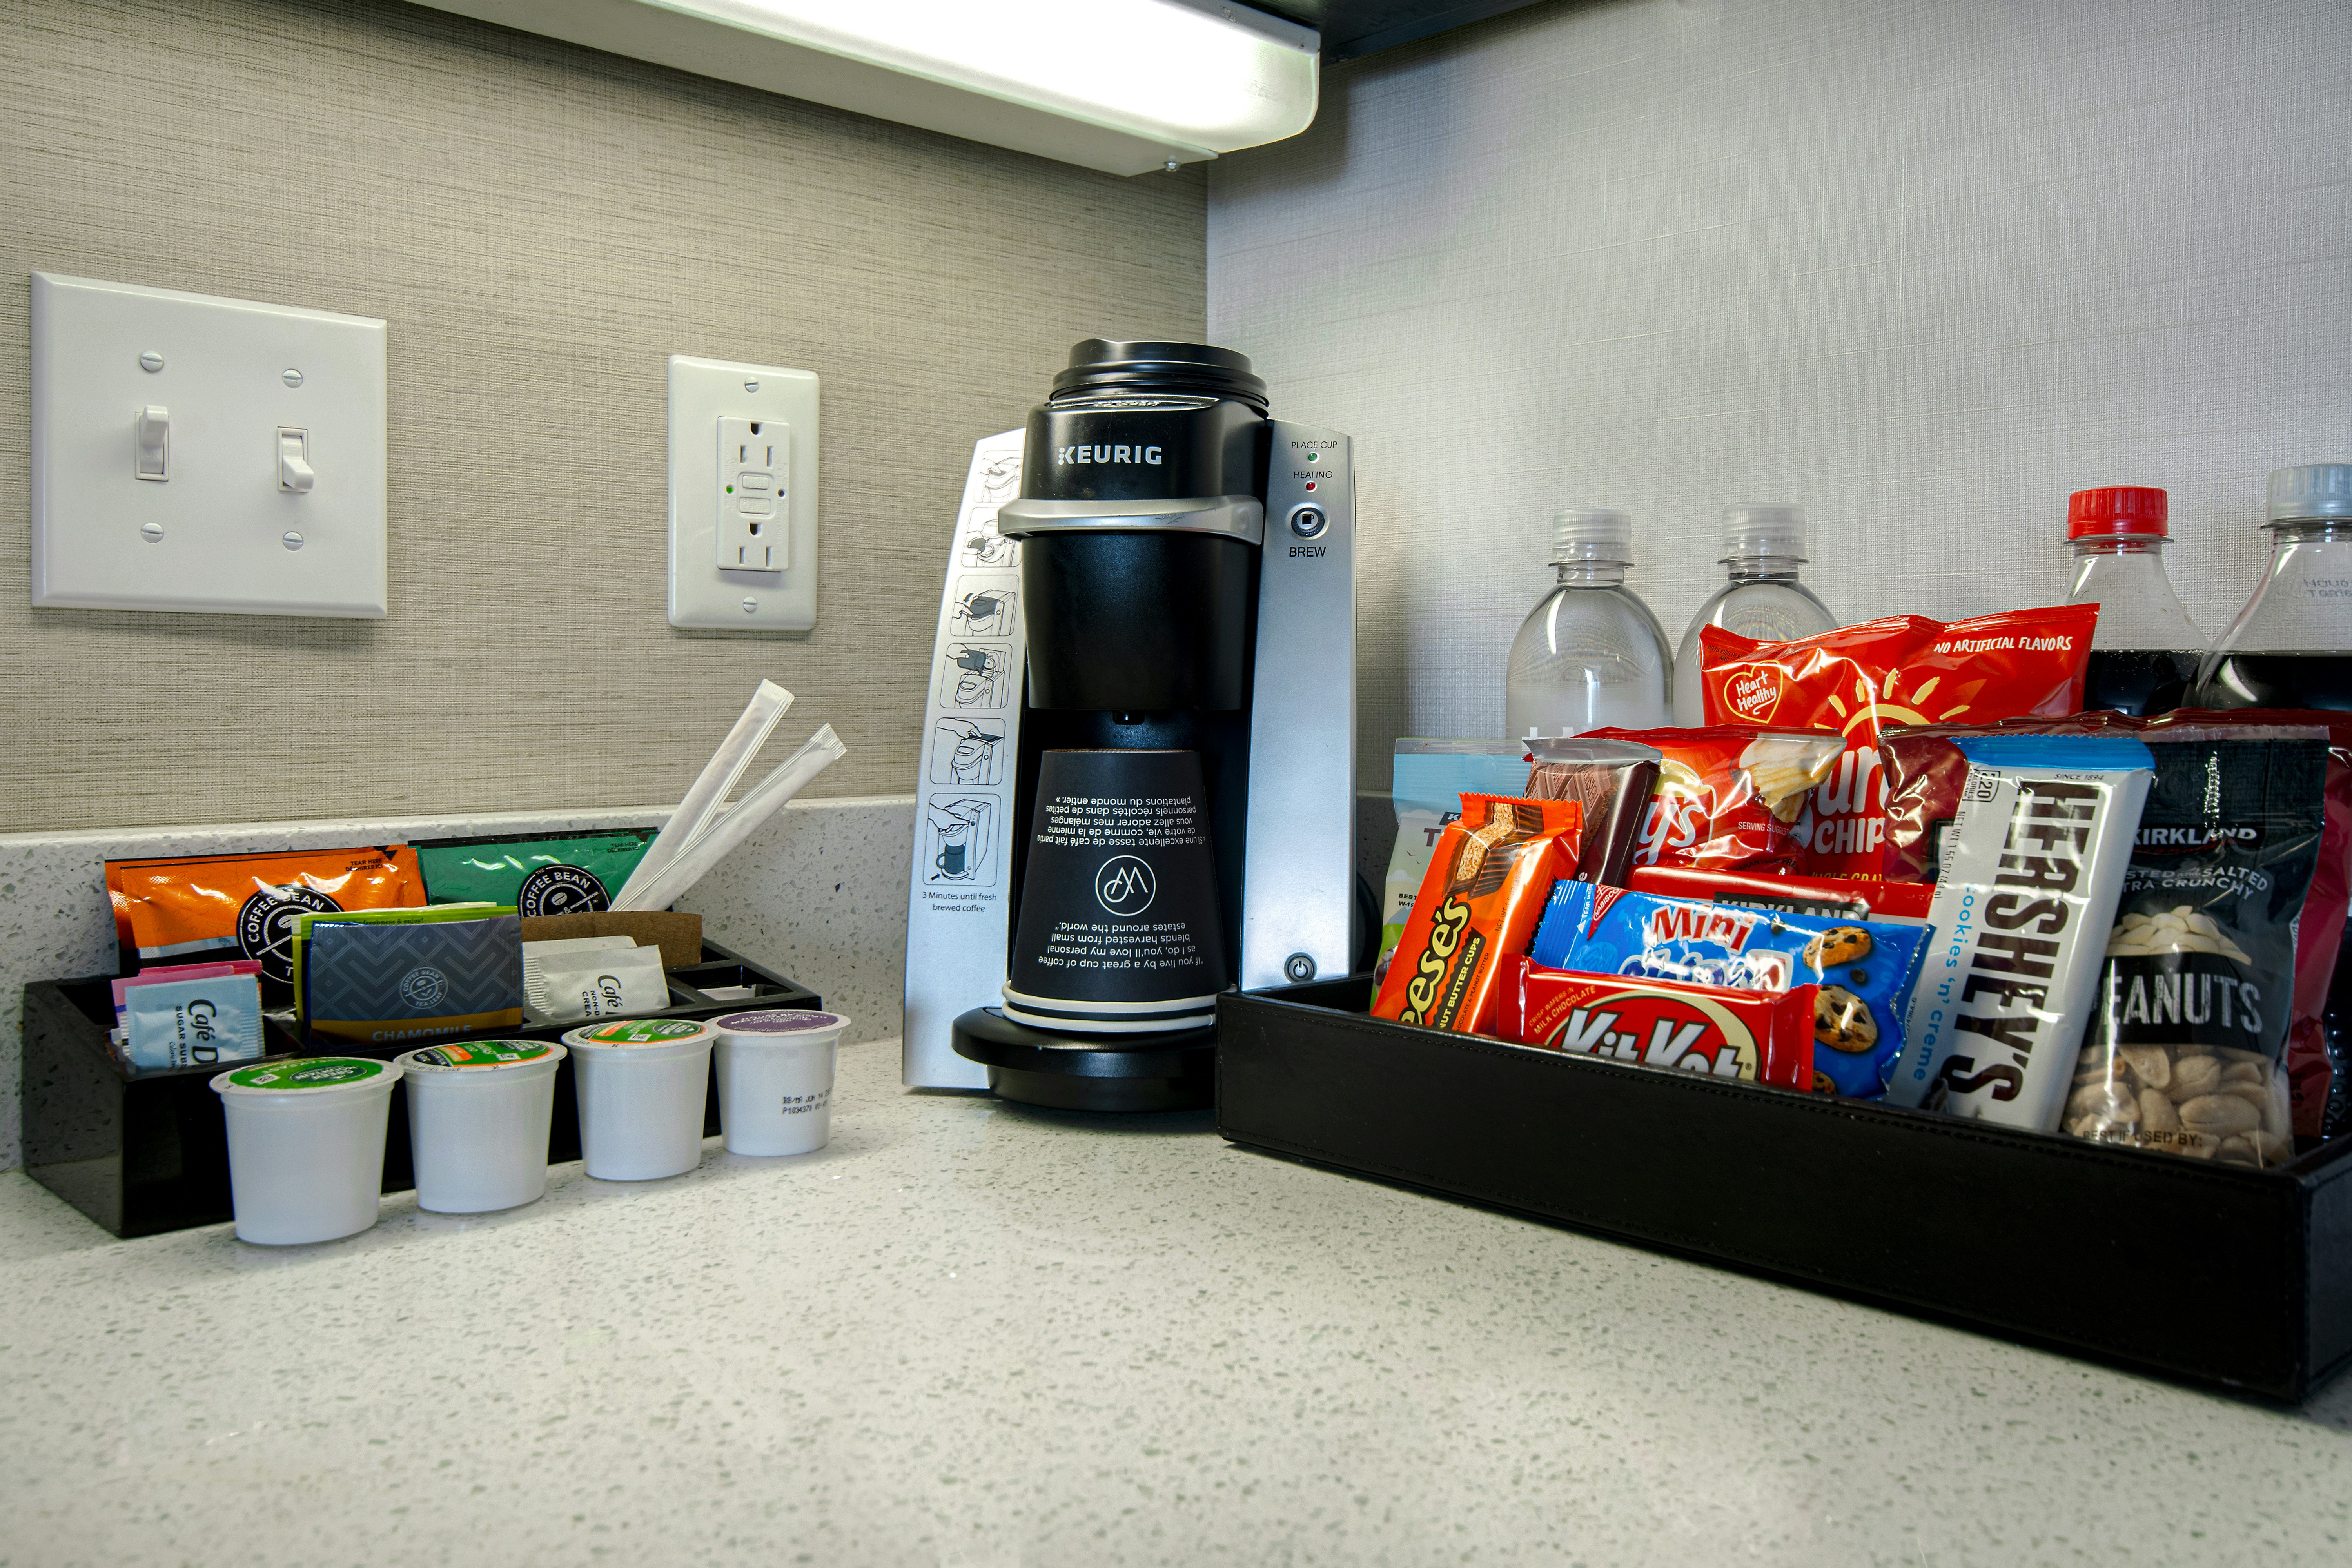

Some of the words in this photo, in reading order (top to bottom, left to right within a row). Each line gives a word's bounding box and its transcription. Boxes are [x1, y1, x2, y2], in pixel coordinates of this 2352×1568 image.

[1058, 445, 1163, 465] KEURIG
[1289, 546, 1326, 557] BREW
[1933, 641, 1951, 653] NO
[1952, 637, 2014, 653] ARTIFICIAL
[2018, 635, 2073, 652] FLAVORS
[1736, 670, 1768, 697] Heart
[1737, 686, 1777, 715] Healthy
[1062, 797, 1088, 806] entier.
[1091, 798, 1126, 807] monde
[1130, 799, 1143, 808] du
[1146, 796, 1191, 807] plantations
[1045, 805, 1070, 815] petites
[1071, 807, 1083, 816] de
[1086, 807, 1110, 817] dans
[1112, 808, 1153, 817] récoltés
[1156, 805, 1196, 817] personnels
[1051, 815, 1091, 827] mélanges
[1117, 819, 1151, 828] adorer
[1154, 818, 1174, 828] allez
[1738, 821, 1766, 831] SERVING
[1047, 826, 1076, 835] mienne
[1078, 828, 1086, 837] la
[1089, 828, 1102, 837] de
[1146, 828, 1162, 837] vie,
[1165, 828, 1186, 836] votre
[1187, 827, 1195, 835] de
[1037, 835, 1054, 843] partie
[1055, 836, 1068, 846] fait
[1070, 837, 1090, 846] café
[1093, 838, 1106, 847] de
[1109, 838, 1136, 847] tasse
[1138, 838, 1183, 847] excellente
[2201, 866, 2268, 891] SALTED
[2161, 877, 2254, 900] CRUNCHY
[526, 875, 552, 917] COFFEE
[554, 871, 590, 889] BEAN
[928, 891, 958, 900] Minutes
[960, 892, 977, 900] until
[979, 893, 997, 901] fresh
[1595, 889, 1620, 918] NABISCO
[1581, 901, 1590, 918] TEAR
[247, 896, 278, 942] COFFEE
[1091, 924, 1109, 933] the
[1112, 924, 1149, 934] around
[1153, 922, 1185, 932] estates
[1652, 904, 1755, 954] Mini
[1051, 933, 1075, 942] small
[1078, 935, 1102, 945] from
[1105, 936, 1157, 945] harvested
[1161, 934, 1190, 944] blends
[1939, 781, 2101, 1102] HERSHEY’S
[1047, 945, 1087, 955] personal
[1090, 946, 1106, 955] my
[1109, 949, 1131, 958] love
[1165, 947, 1180, 956] do,
[1038, 956, 1064, 967] coffee
[1066, 959, 1077, 968] of
[1080, 959, 1099, 968] cup
[1102, 960, 1131, 969] great
[1143, 959, 1156, 969] by
[1160, 960, 1176, 968] live
[1179, 956, 1193, 965] you
[1449, 966, 1470, 1008] BUTTER
[1465, 937, 1481, 965] CUPS
[1470, 973, 1479, 997] PEANUT
[1478, 953, 1489, 974] BUTTER
[403, 971, 420, 991] COFFEE
[422, 970, 440, 979] BEAN
[597, 975, 622, 1008] Café
[2092, 973, 2263, 1033] EANUTS
[1528, 1008, 1544, 1027] CRISP
[1544, 991, 1567, 1010] WAFERS
[1534, 1015, 1552, 1035] MILK
[1551, 985, 1597, 1018] CHOCOLATE
[176, 1005, 185, 1040] SUGAR
[188, 998, 217, 1042] Café
[1913, 1010, 1943, 1081] creme
[2178, 1132, 2202, 1147] BY:
